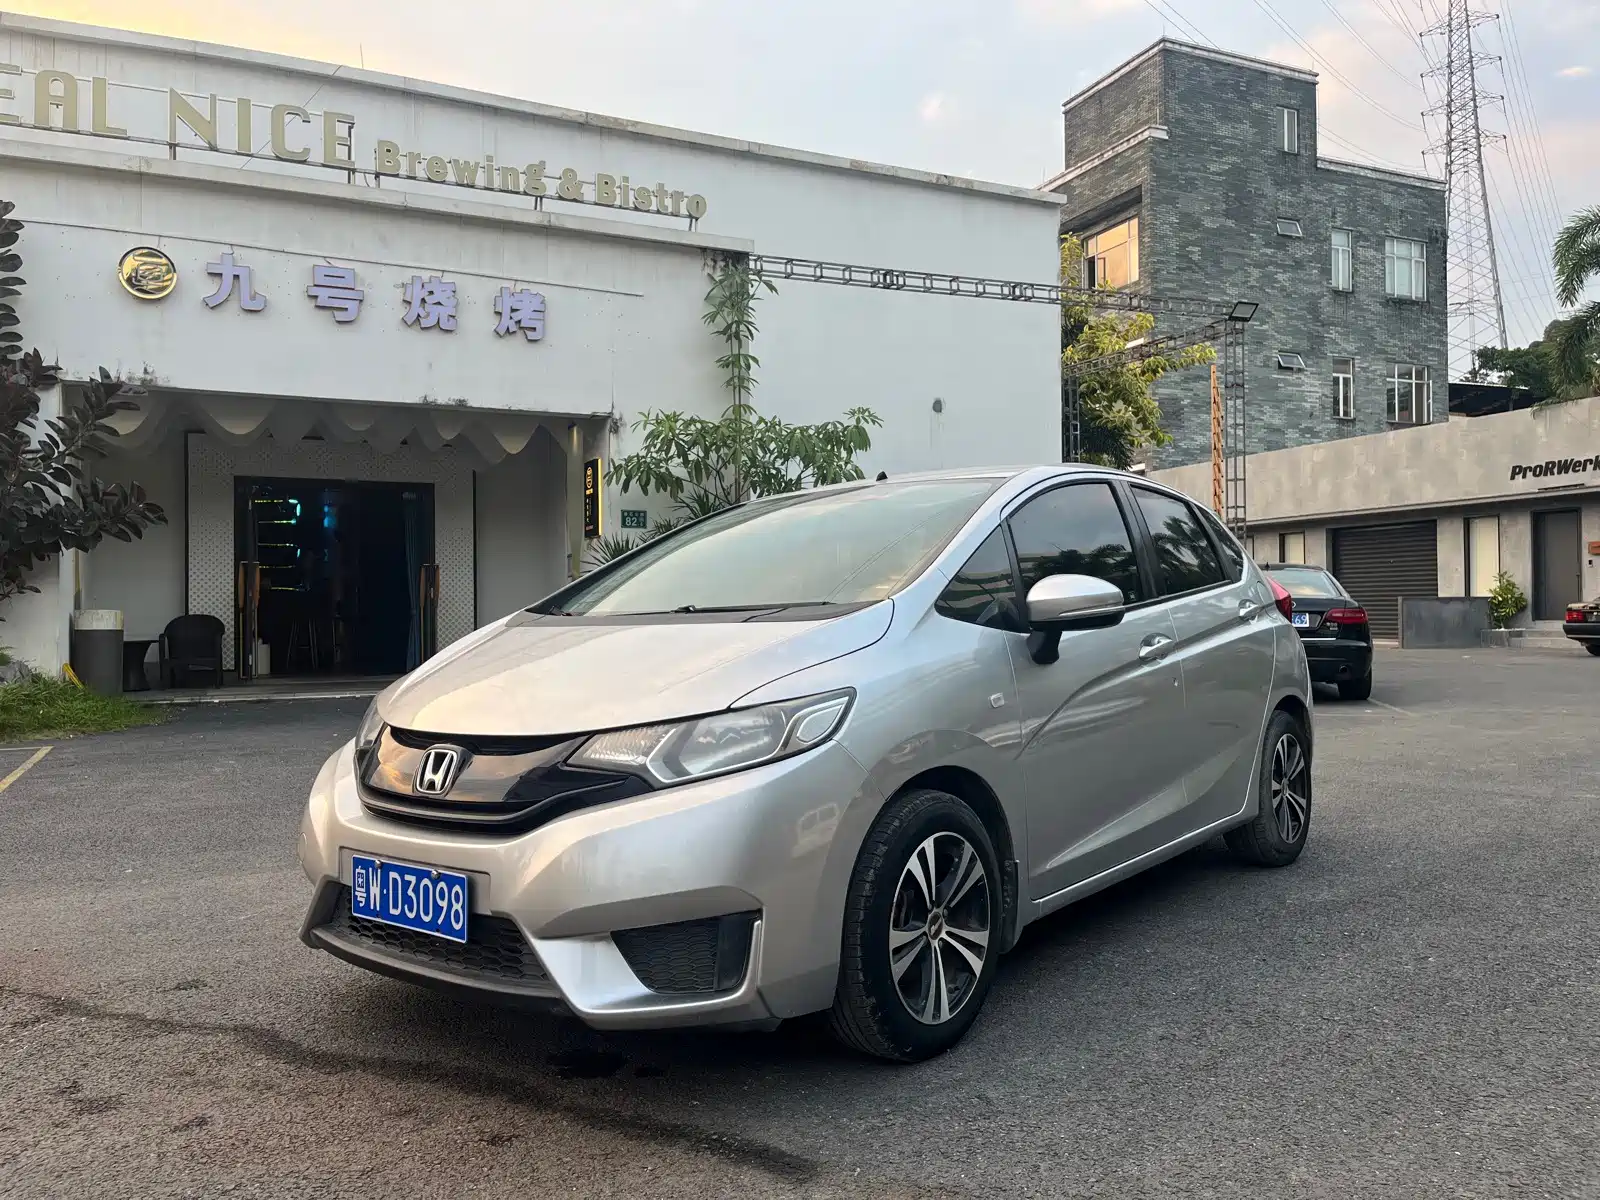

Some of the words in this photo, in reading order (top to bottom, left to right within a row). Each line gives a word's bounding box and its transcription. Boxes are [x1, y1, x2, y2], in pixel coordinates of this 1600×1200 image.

[168, 86, 356, 168] NICE
[376, 139, 547, 195] Brewing
[556, 166, 584, 202] &
[594, 172, 708, 219] Bistro
[202, 252, 547, 341] 九号烧烤
